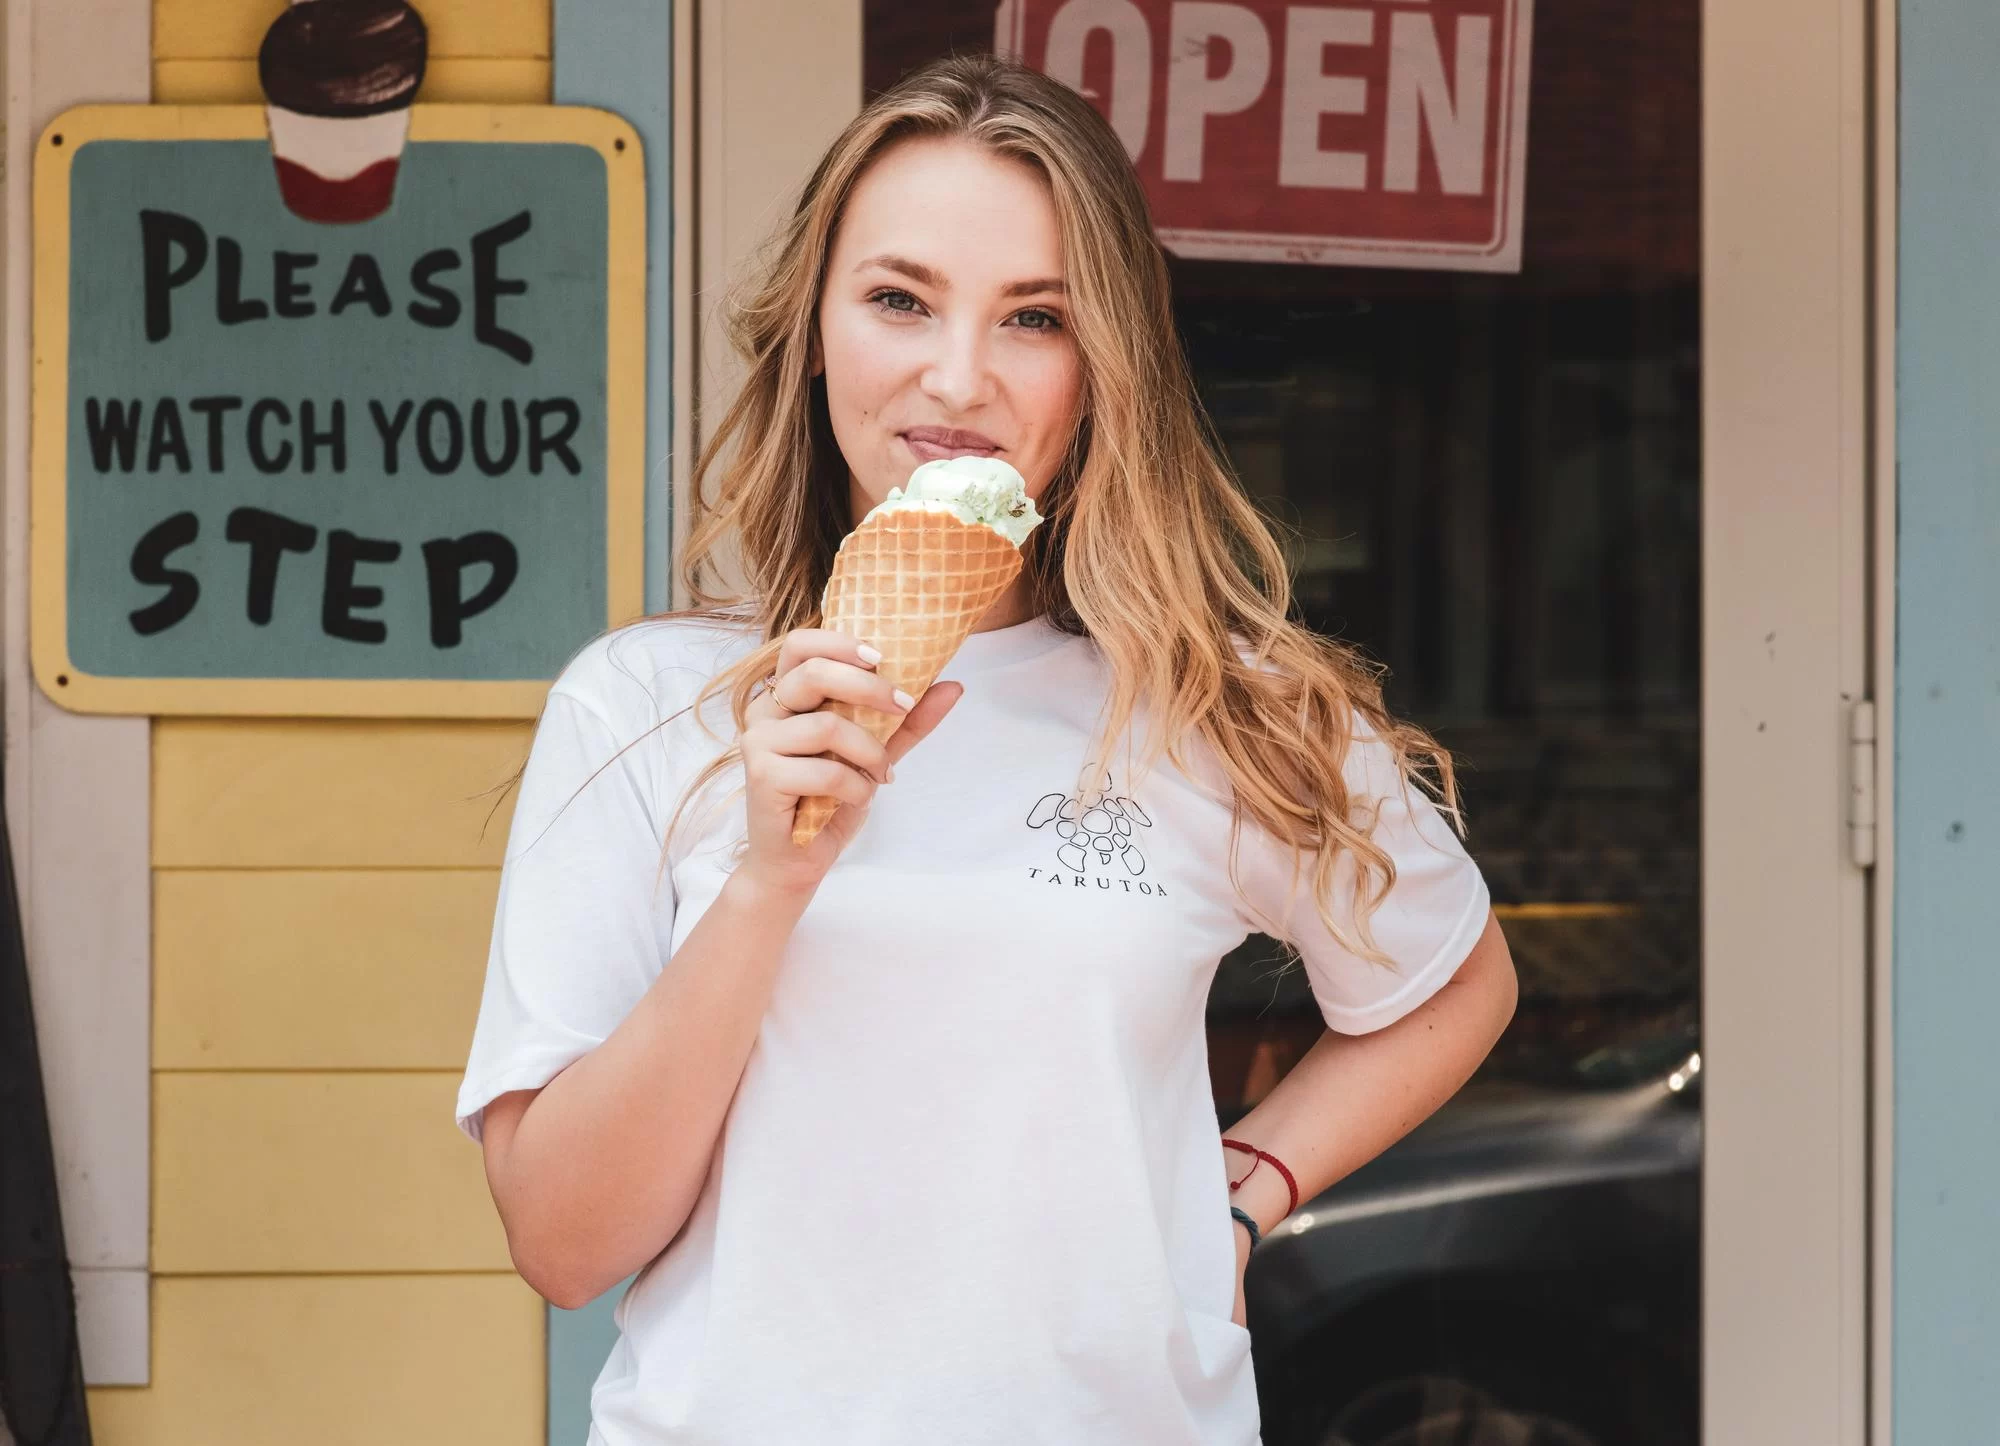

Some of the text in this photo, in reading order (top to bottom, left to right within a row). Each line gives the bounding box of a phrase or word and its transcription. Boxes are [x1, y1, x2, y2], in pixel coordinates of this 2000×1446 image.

[1044, 0, 1491, 196] OPEN
[139, 209, 533, 365] PLEASE
[86, 397, 581, 476] WATCH YOUR
[129, 507, 518, 648] STEP
[1029, 867, 1167, 897] TARUTOA
